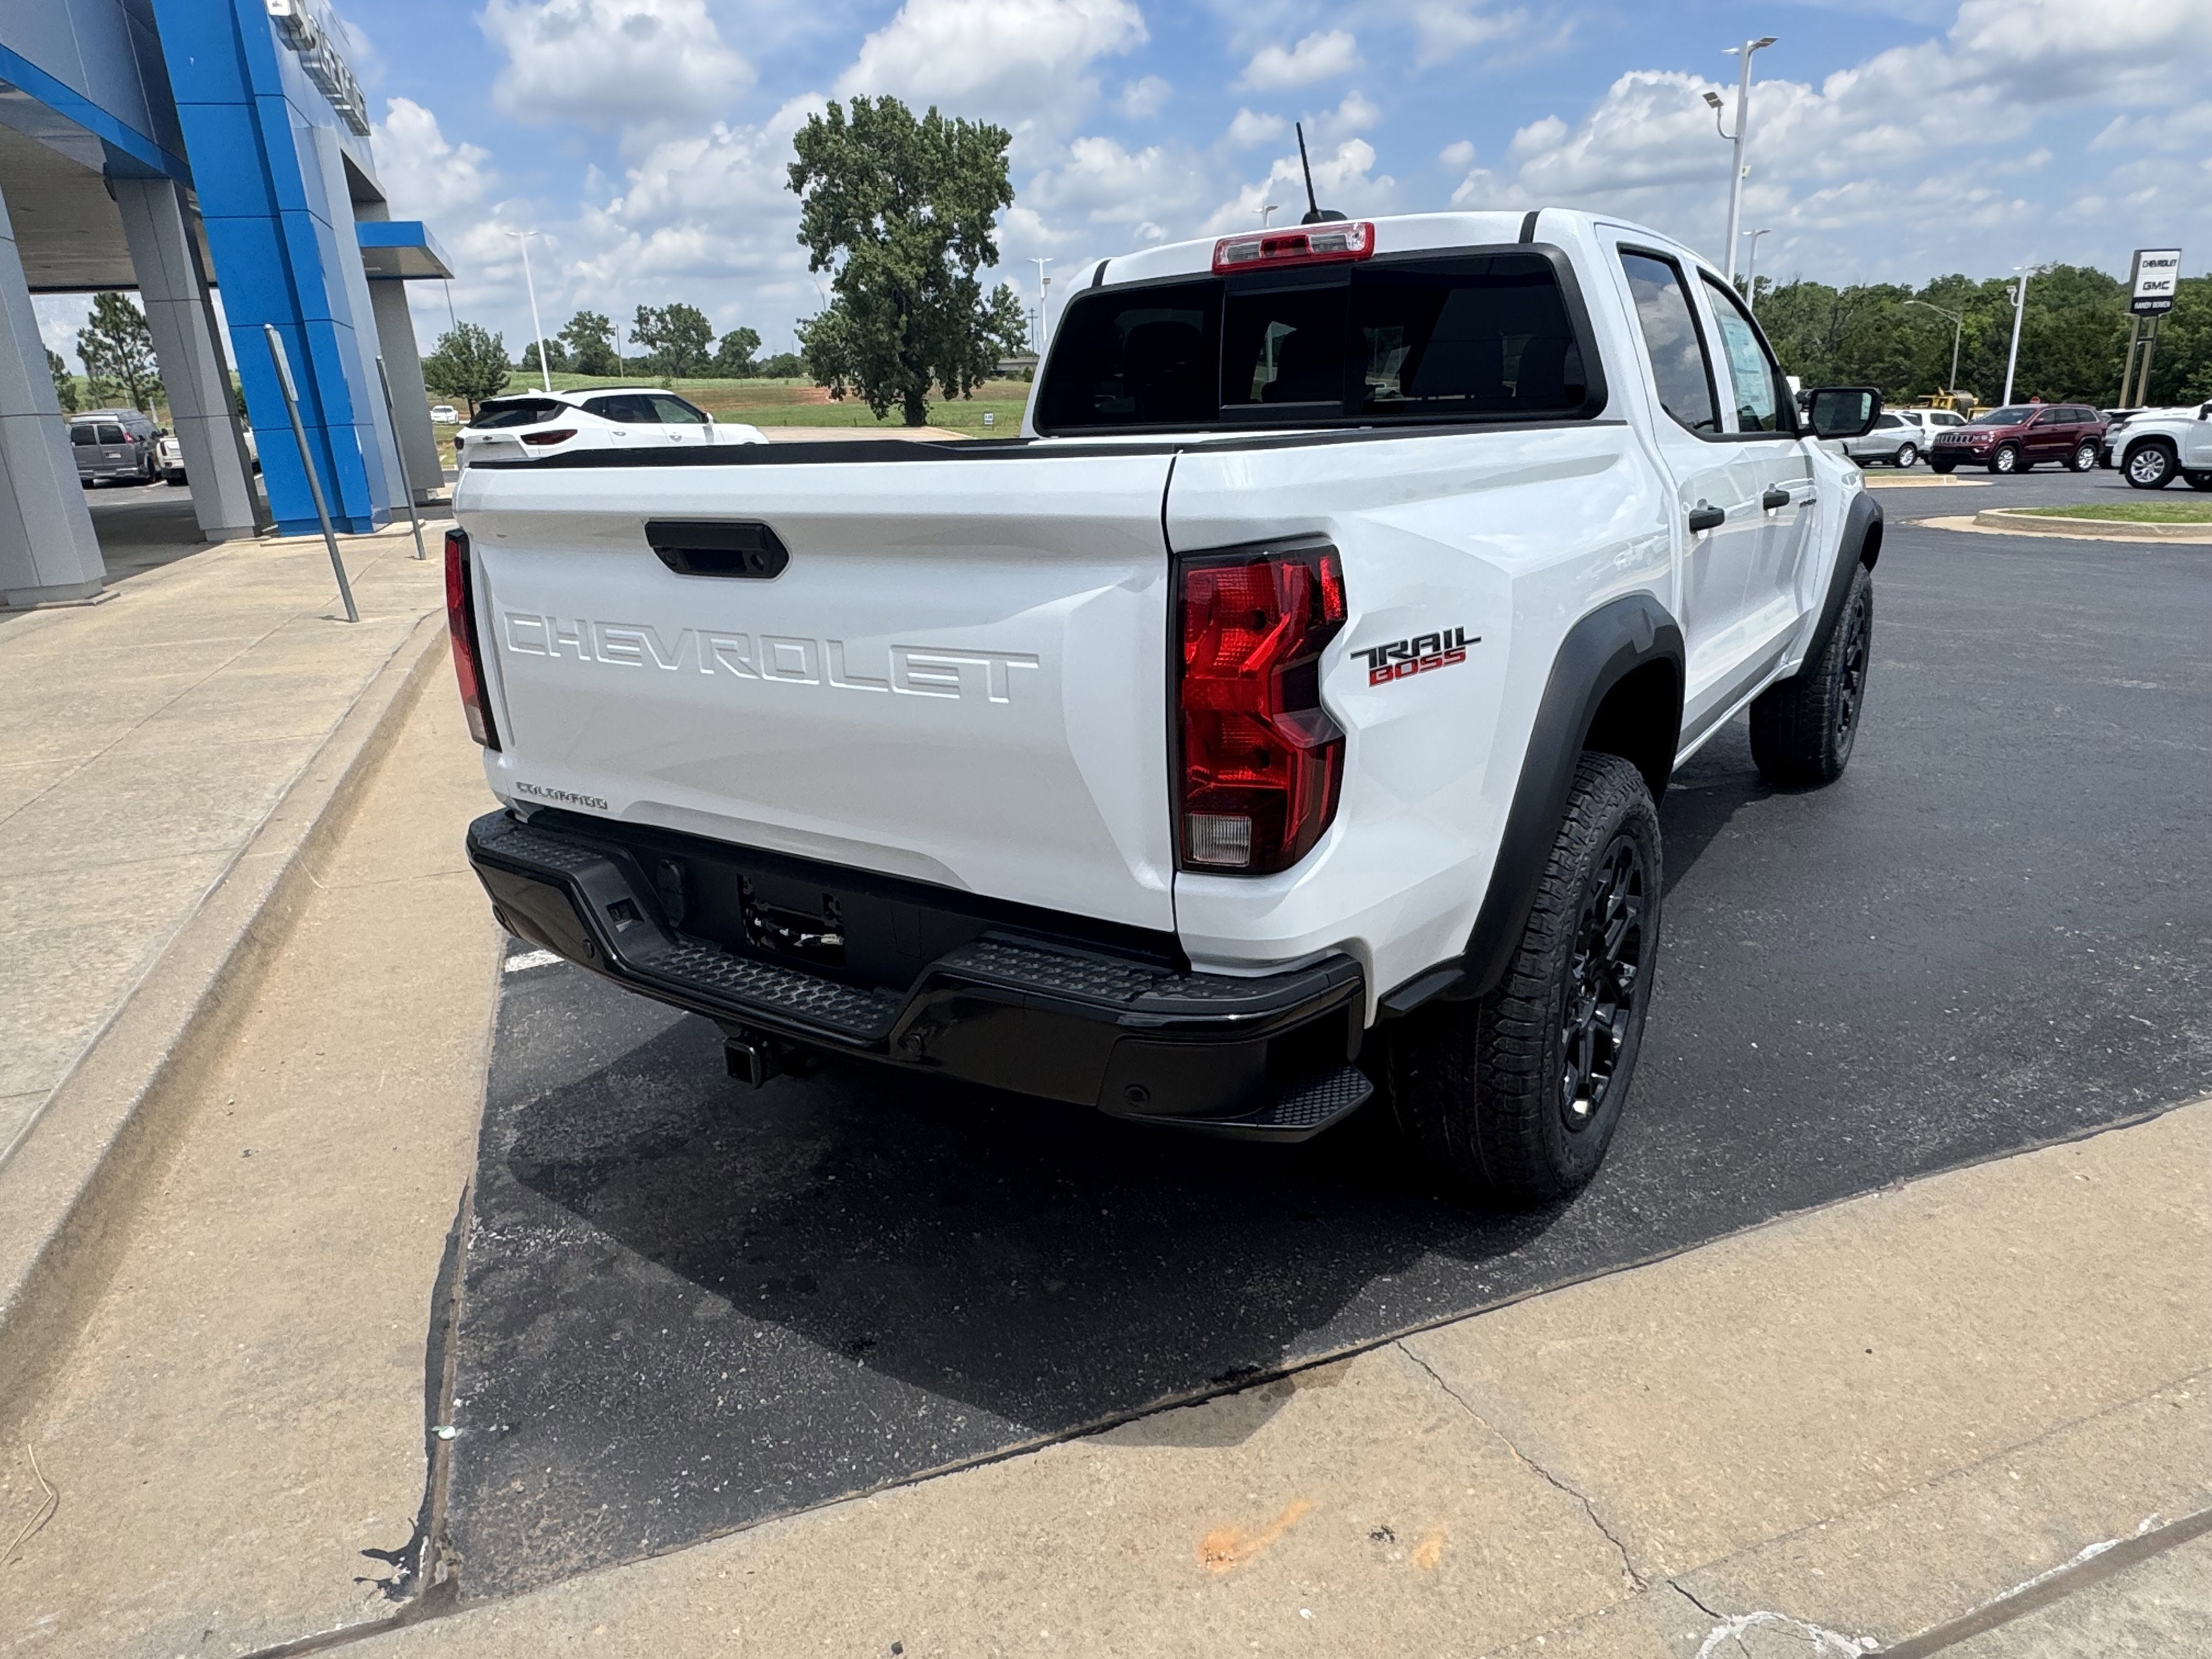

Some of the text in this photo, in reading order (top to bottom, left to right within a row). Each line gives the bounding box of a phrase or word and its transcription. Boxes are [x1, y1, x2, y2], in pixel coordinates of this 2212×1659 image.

[2142, 259, 2177, 268] CHEVROLET
[2142, 281, 2170, 290] GMC
[504, 612, 1040, 703] CHEVROLET
[1350, 626, 1482, 669] TRAIL
[1369, 646, 1466, 688] BOSS
